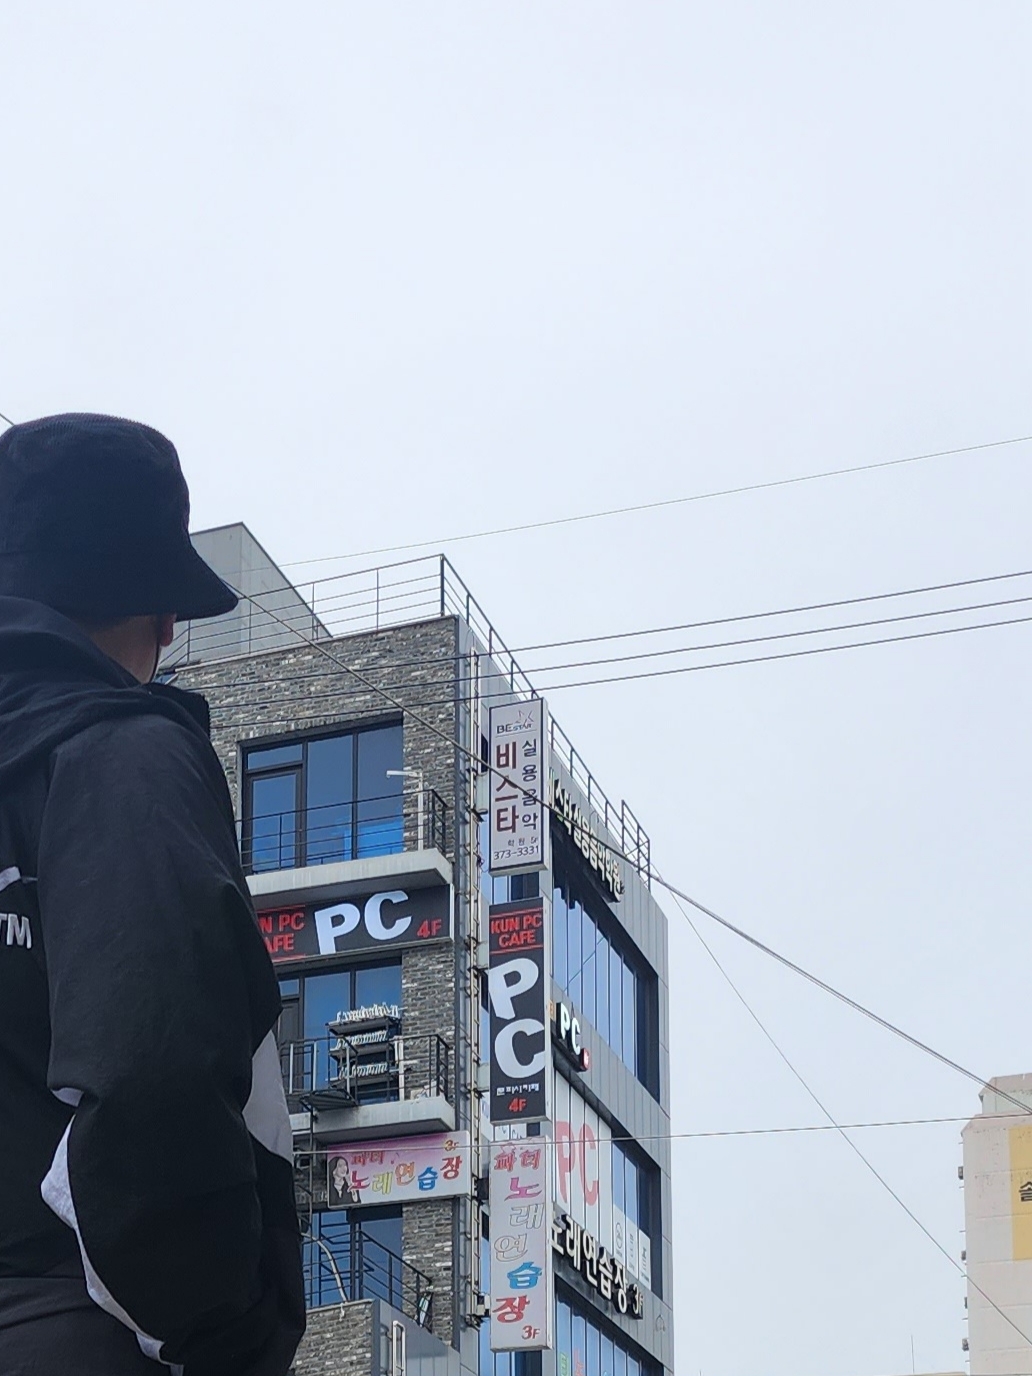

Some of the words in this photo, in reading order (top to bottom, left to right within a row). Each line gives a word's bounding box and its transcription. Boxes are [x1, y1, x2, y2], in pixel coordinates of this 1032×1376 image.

[495, 741, 519, 834] 비스타
[521, 738, 539, 831] 실용음악
[494, 845, 539, 861] 373-3331
[278, 911, 305, 932] PC
[314, 890, 415, 955] PC
[417, 919, 443, 939] 4F
[491, 915, 520, 934] KUN
[521, 912, 542, 930] PC
[264, 932, 294, 954] AFE
[498, 929, 537, 948] CAFE
[489, 957, 545, 1080] PC
[560, 1002, 581, 1056] PC
[509, 1097, 527, 1112] 4F
[348, 1156, 463, 1195] 노래연습장
[493, 1177, 545, 1325] 노래연습장
[522, 1324, 541, 1341] 3F
